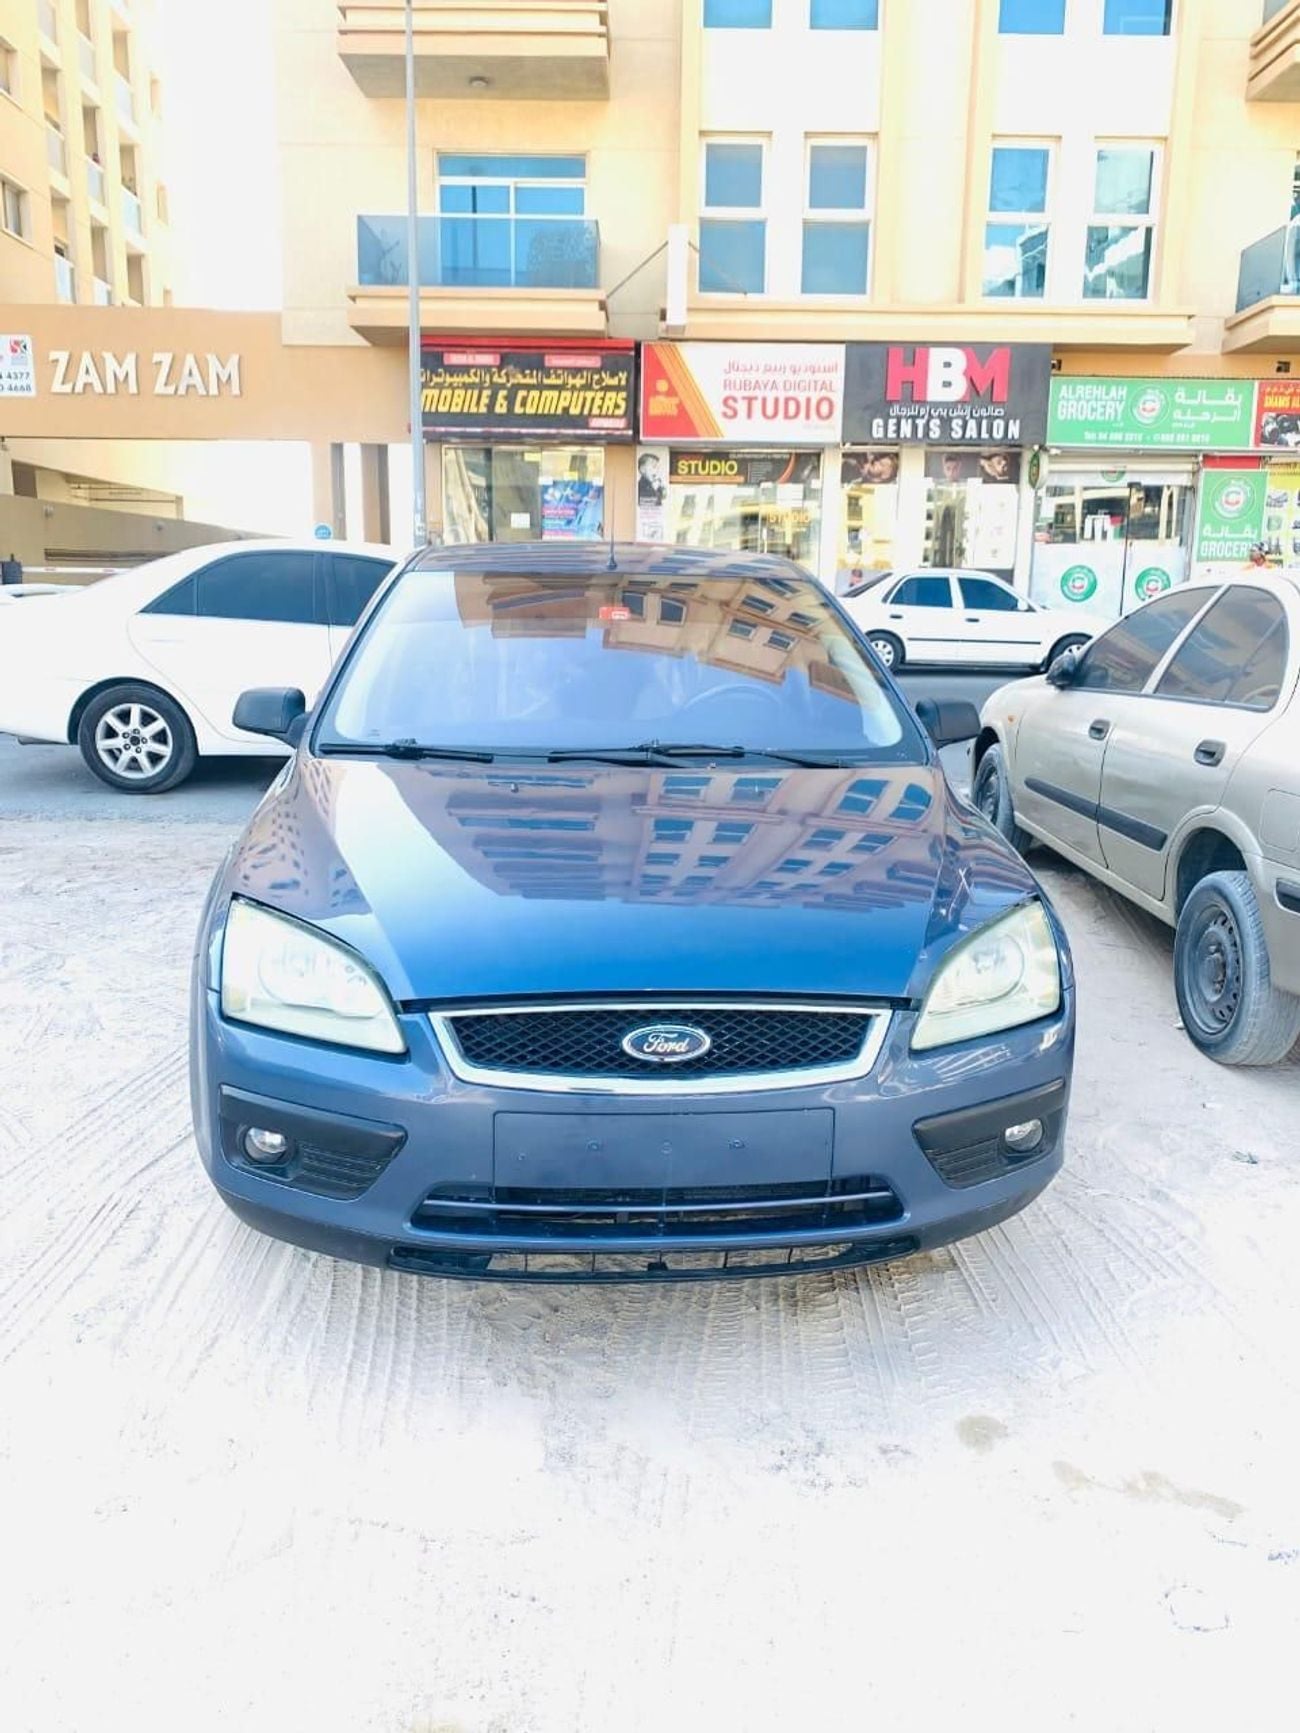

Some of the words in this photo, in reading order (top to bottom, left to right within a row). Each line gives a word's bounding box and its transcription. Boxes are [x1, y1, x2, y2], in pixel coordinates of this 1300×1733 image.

[48, 350, 139, 394] ZAM
[152, 352, 241, 396] ZAM
[885, 346, 1012, 402] HBM
[723, 379, 779, 392] RUBAYA
[783, 380, 837, 393] DIGITAL
[1059, 384, 1127, 400] ALREHLAH
[1174, 386, 1242, 406] بقالة
[421, 388, 491, 414] MOBILE
[514, 389, 627, 416] COMPUTERS
[721, 395, 835, 421] STUDIO
[889, 404, 918, 417] للرجال
[972, 404, 1005, 418] صالون
[1057, 401, 1126, 421] GROCERY
[871, 417, 941, 440] GENTS
[950, 418, 1021, 440] SALON
[677, 460, 738, 475] STUDIO
[643, 1033, 690, 1052] Ford
